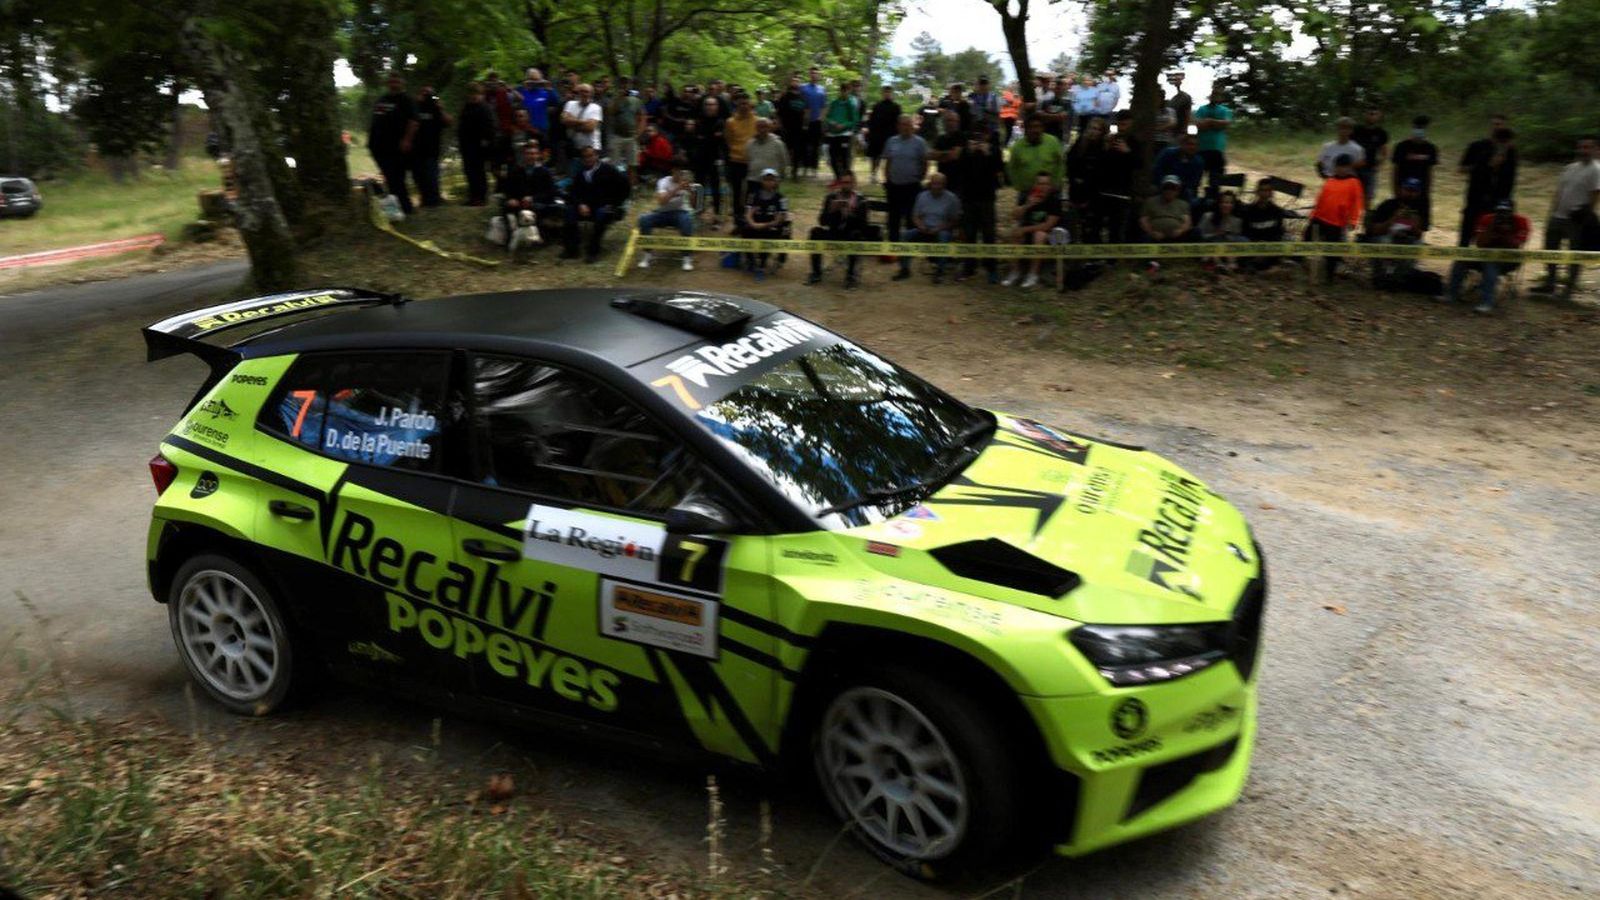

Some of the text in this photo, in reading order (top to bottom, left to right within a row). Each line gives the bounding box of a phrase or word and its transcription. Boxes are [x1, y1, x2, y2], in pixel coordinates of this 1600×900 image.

[651, 375, 701, 410] 7
[291, 390, 317, 437] 7
[374, 406, 436, 431] J. Pardo
[326, 428, 431, 459] D. de la Puente
[530, 519, 562, 543] La
[332, 510, 557, 640] Recalvi
[679, 540, 709, 582] 7
